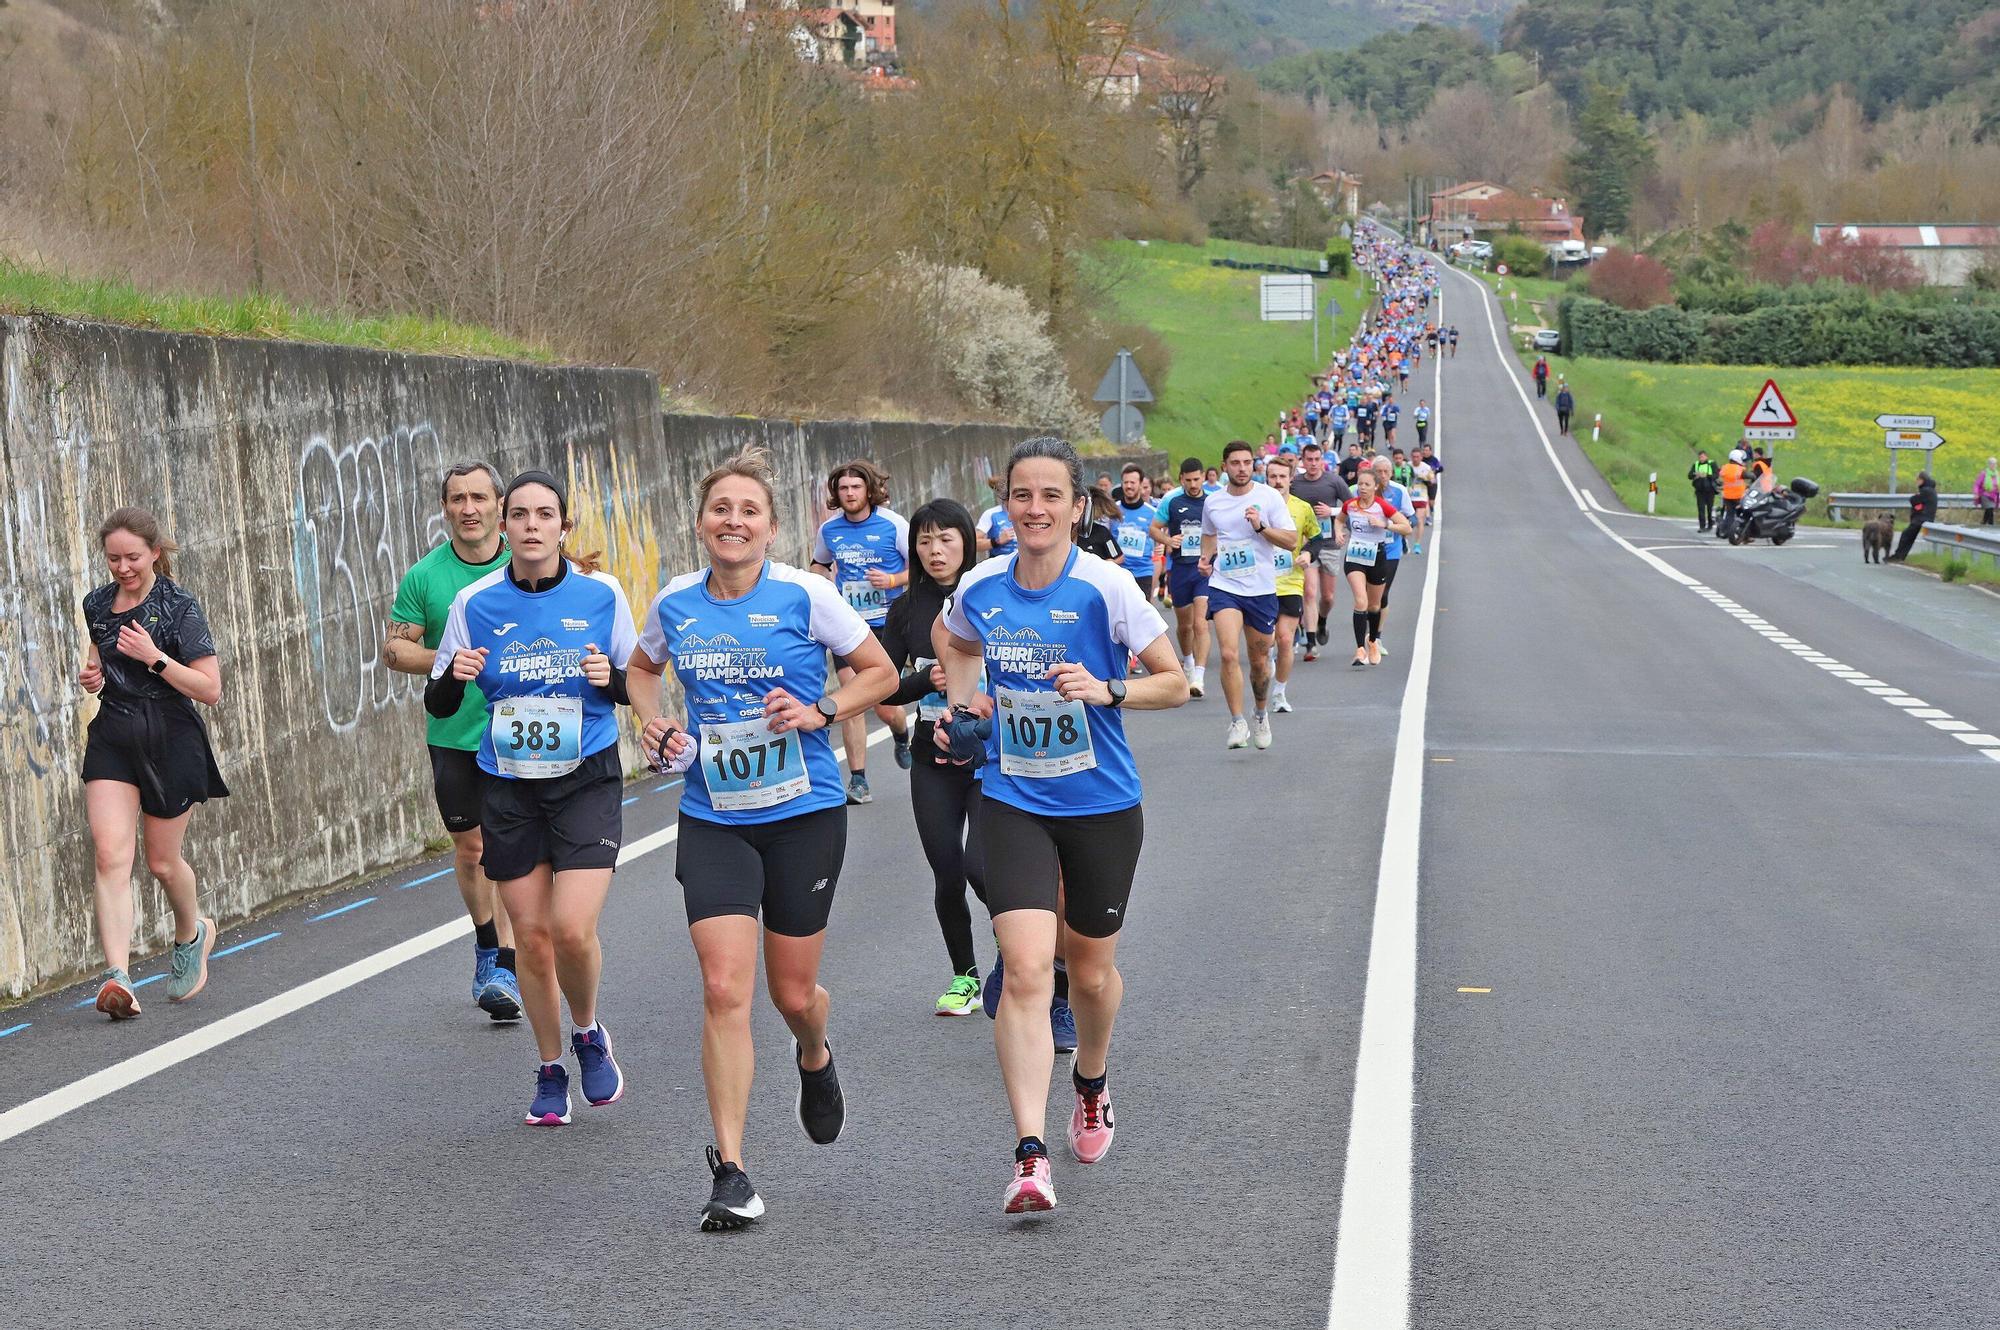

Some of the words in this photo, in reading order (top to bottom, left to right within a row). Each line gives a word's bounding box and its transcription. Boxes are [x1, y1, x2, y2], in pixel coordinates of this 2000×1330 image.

[1123, 536, 1139, 547] 921
[1225, 551, 1247, 566] 315
[1352, 546, 1373, 558] 1121
[848, 591, 881, 607] 1140
[696, 666, 785, 681] PAMPLONA
[1000, 661, 1051, 674] PAMPL
[510, 720, 561, 751] 383
[1007, 713, 1079, 748] 1078
[713, 737, 787, 781] 1077
